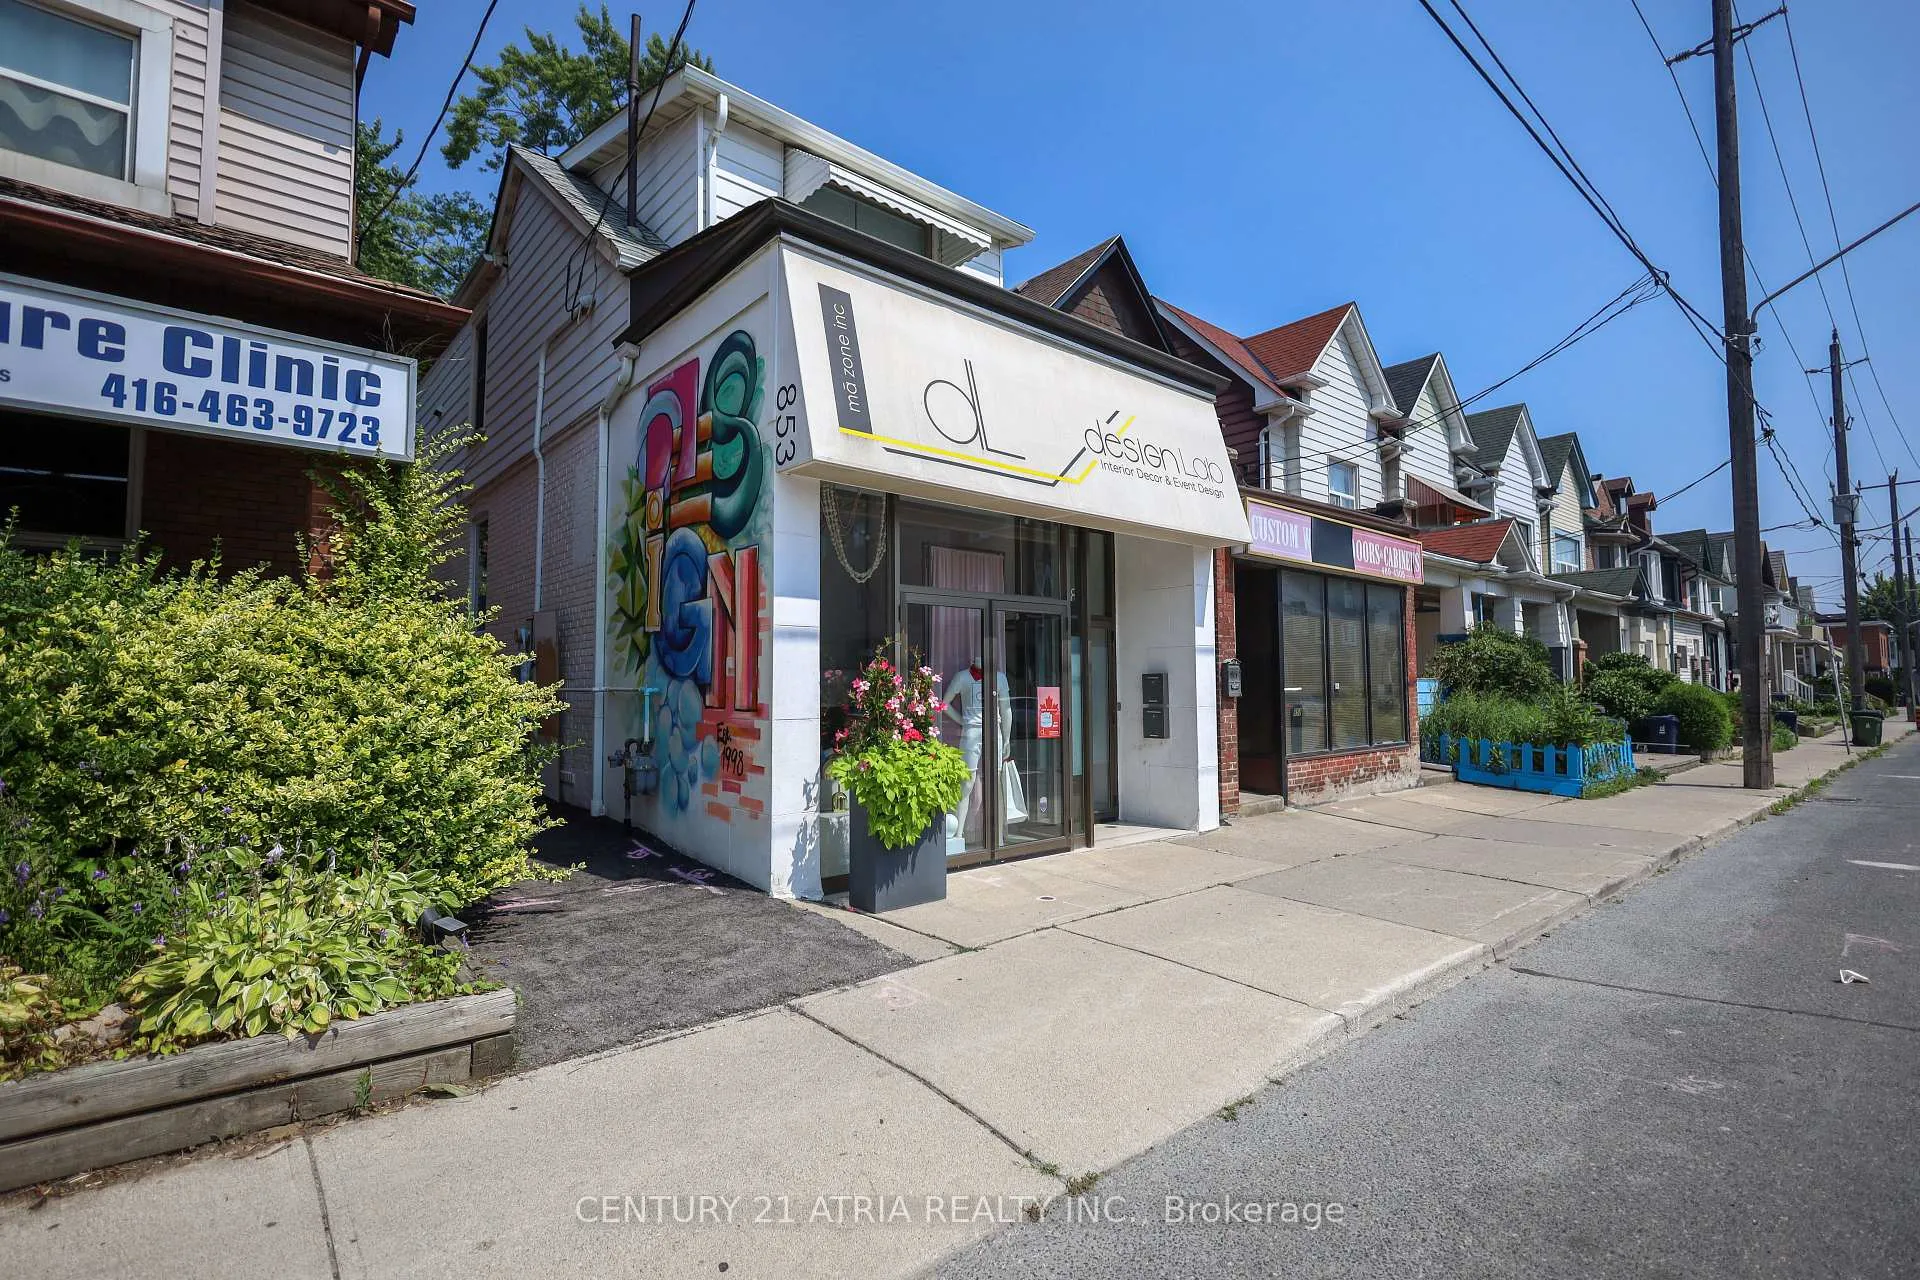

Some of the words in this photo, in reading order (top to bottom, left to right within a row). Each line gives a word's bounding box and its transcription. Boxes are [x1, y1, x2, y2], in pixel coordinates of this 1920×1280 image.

[833, 303, 848, 330] inc
[163, 325, 382, 408] Clinic
[838, 334, 856, 379] zone
[101, 372, 380, 447] 416-463-9723
[776, 383, 797, 467] 853
[1100, 459, 1134, 477] Interior
[1137, 467, 1163, 483] Decor
[1165, 475, 1172, 486] &
[1173, 476, 1197, 491] Event
[1198, 483, 1225, 499] Design
[1251, 514, 1298, 549] CUSTOM
[1352, 539, 1380, 565] OORS
[1384, 545, 1420, 573] CABINETS
[721, 745, 744, 776] 1998
